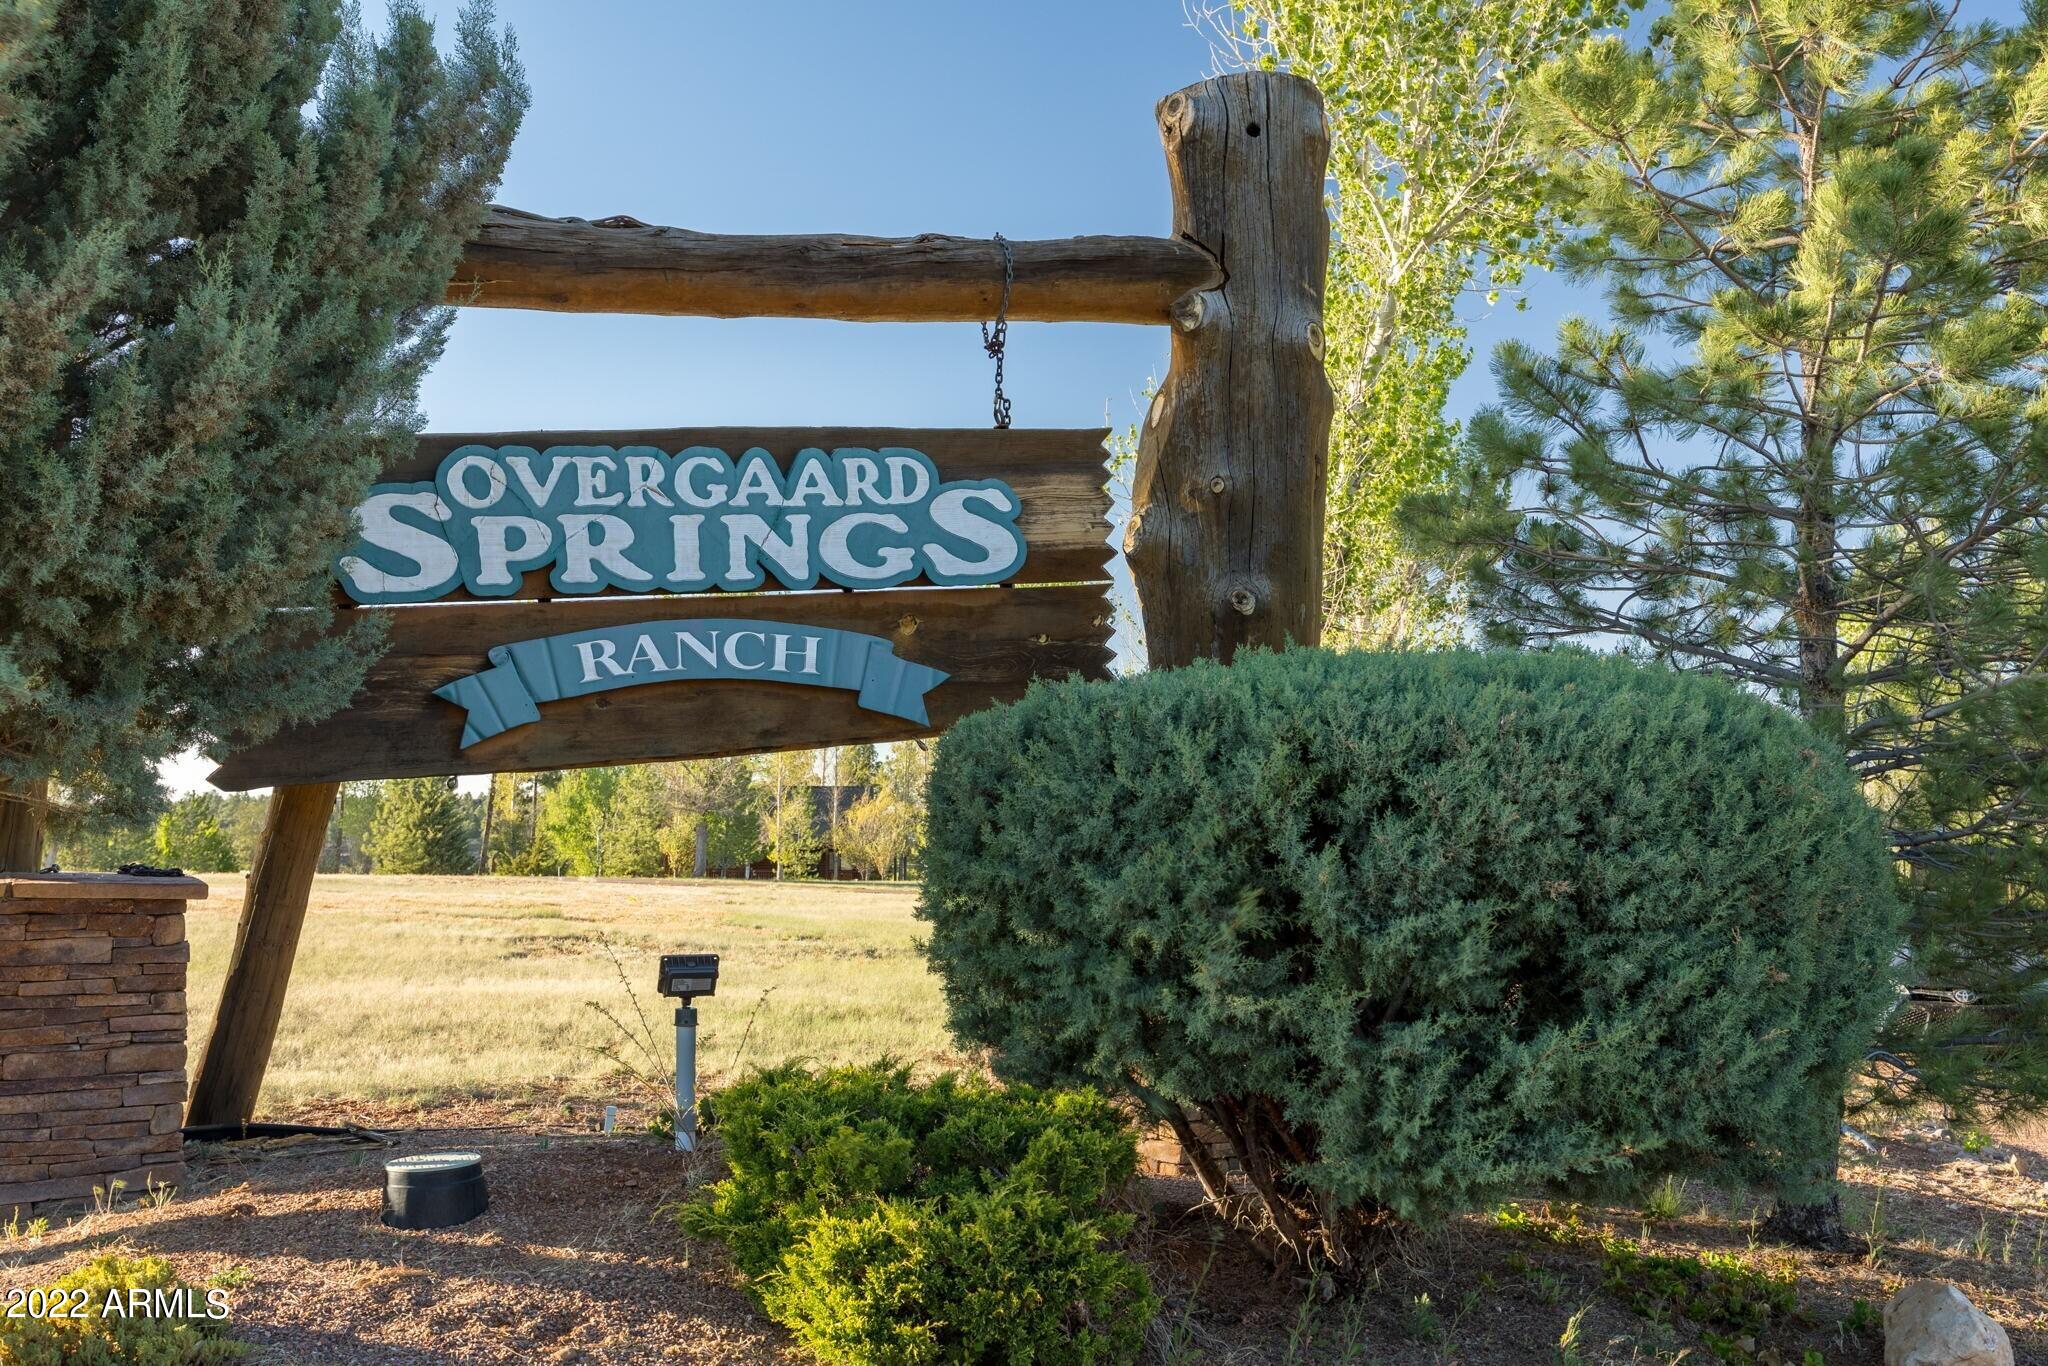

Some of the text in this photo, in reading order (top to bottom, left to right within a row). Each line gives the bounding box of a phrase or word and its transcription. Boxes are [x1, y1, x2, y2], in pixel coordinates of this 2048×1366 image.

[446, 455, 930, 508] OVERGAARD
[340, 488, 1018, 593] SPRINGS
[572, 630, 823, 683] RANCH
